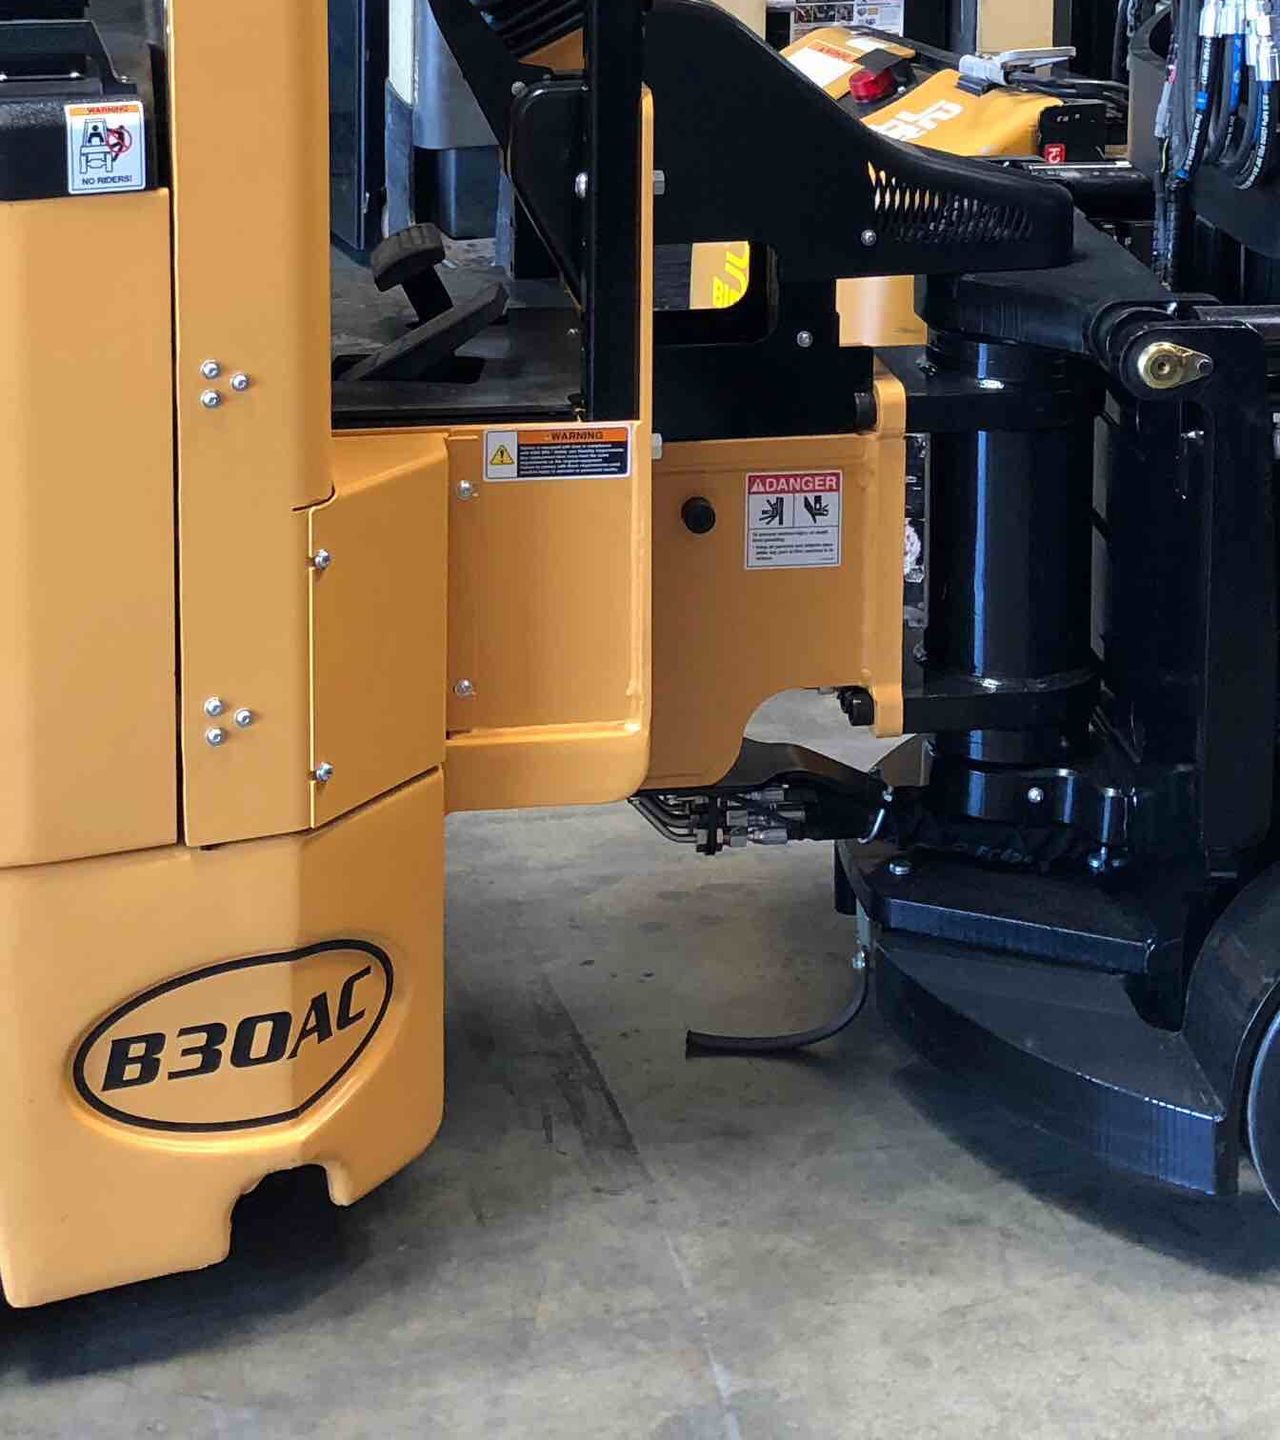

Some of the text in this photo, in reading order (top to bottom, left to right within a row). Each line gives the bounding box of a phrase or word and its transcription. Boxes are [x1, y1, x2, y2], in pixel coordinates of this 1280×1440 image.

[81, 174, 133, 185] NO RIDERS!
[550, 431, 604, 441] WARNING
[765, 476, 837, 492] DANGER
[101, 965, 372, 1092] B30AC
